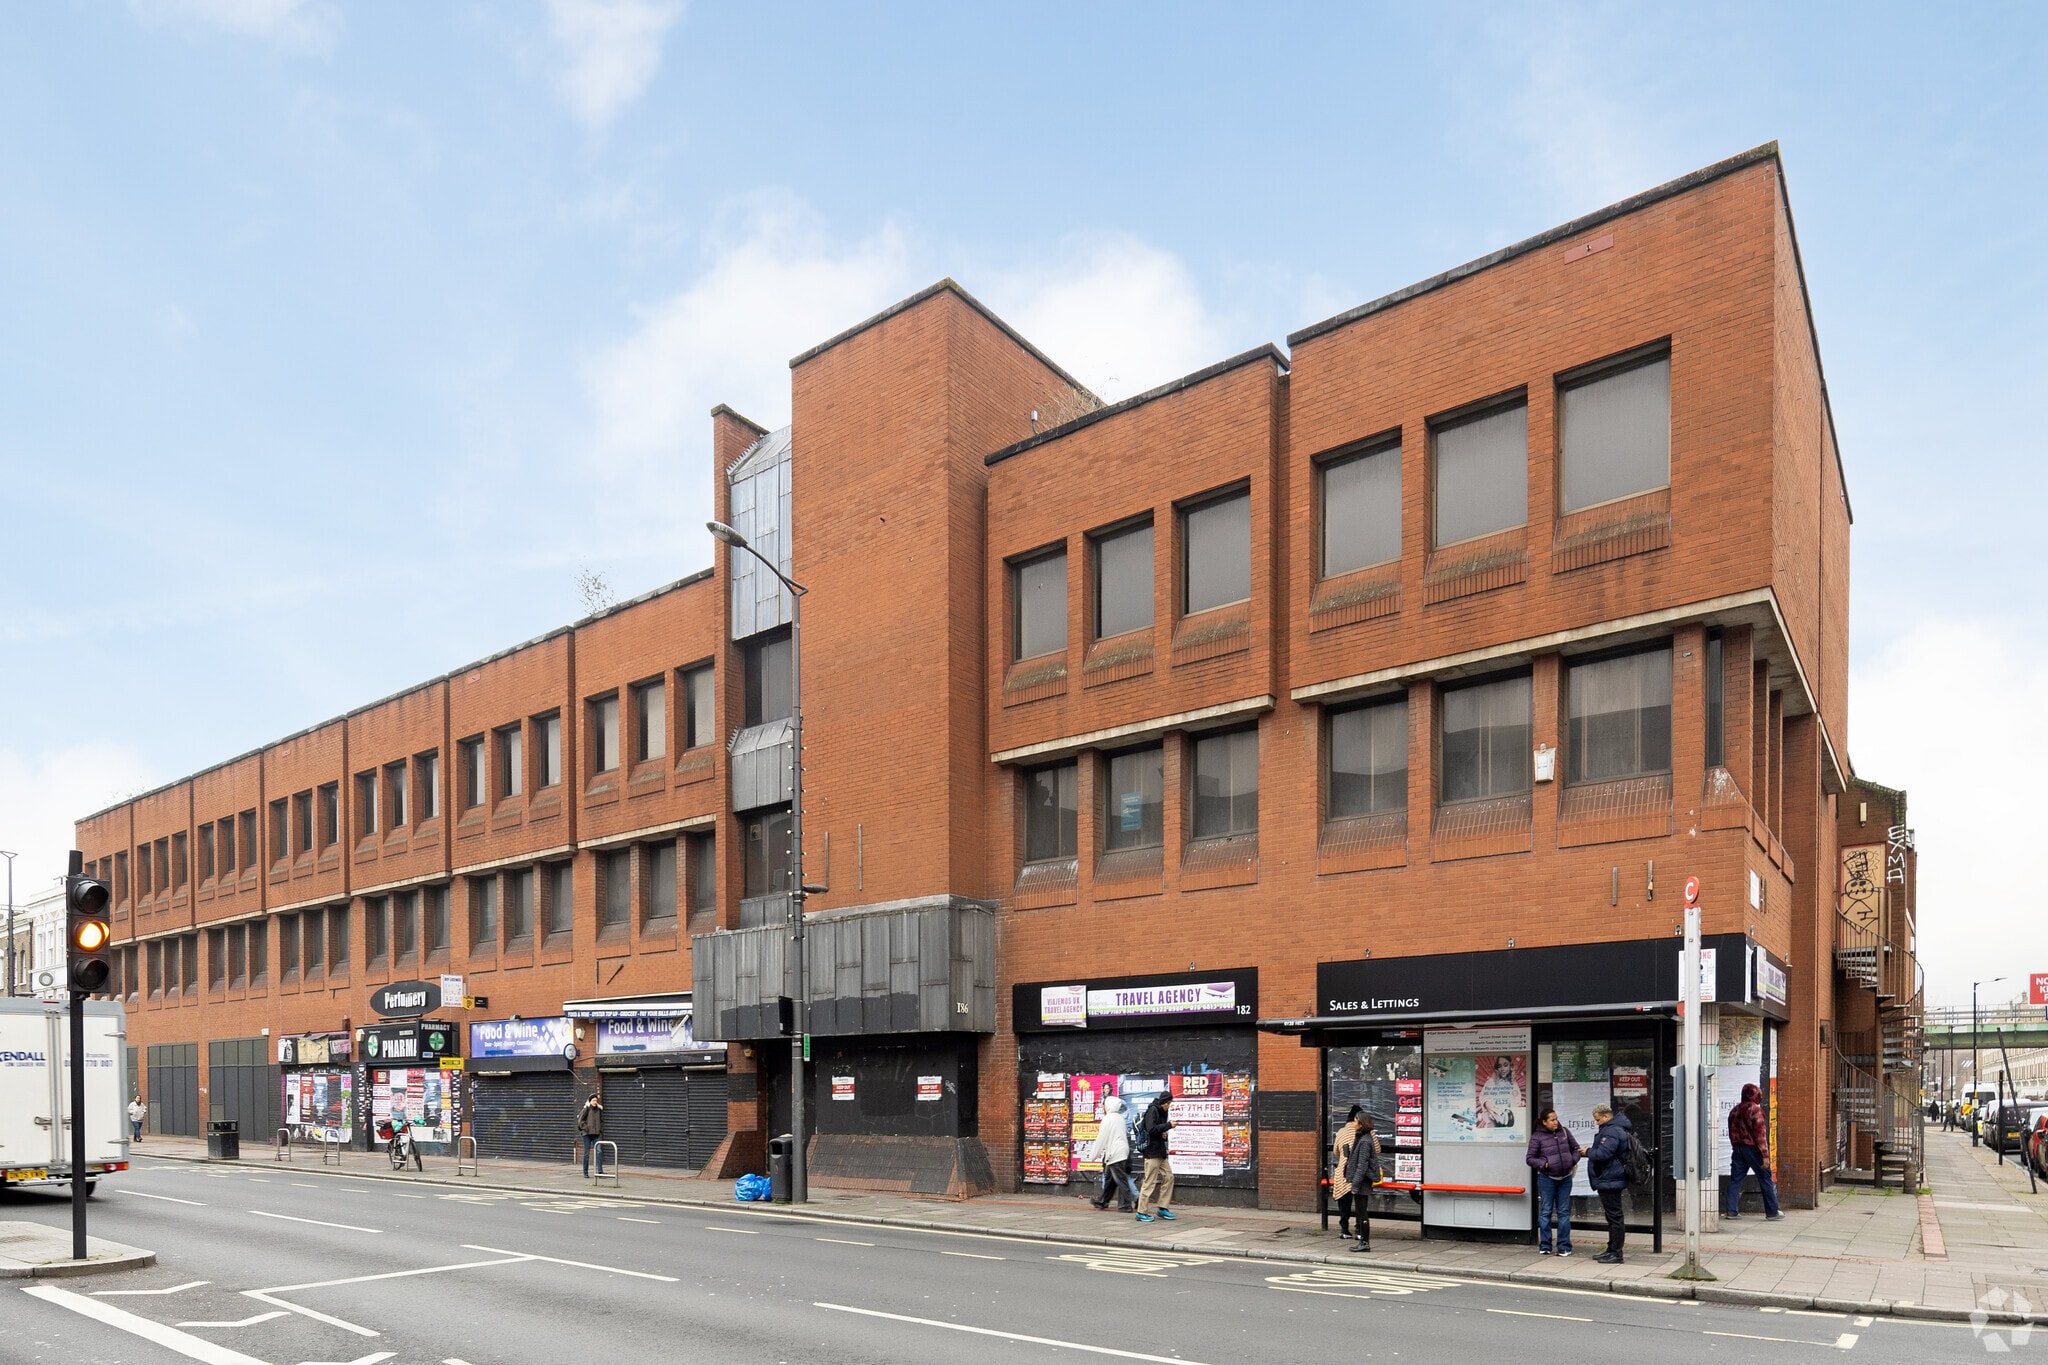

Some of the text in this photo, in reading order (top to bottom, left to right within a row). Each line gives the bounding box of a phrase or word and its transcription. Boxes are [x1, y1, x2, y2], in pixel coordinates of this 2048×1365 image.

[1685, 882, 1694, 900] C
[384, 991, 426, 1010] Perfumery
[1116, 991, 1154, 1006] TRAVEL
[1158, 988, 1201, 1004] AGENCY
[956, 1002, 969, 1014] 186
[1045, 1006, 1062, 1014] TRAVEL
[1063, 1004, 1083, 1013] AGENCY
[1236, 1004, 1251, 1015] 182
[1361, 1000, 1368, 1010] &
[421, 1023, 450, 1031] PHARMACY
[480, 1022, 538, 1040] Food & Wine
[608, 1017, 673, 1034] Food & Wine
[1183, 1076, 1209, 1089] RED
[1182, 1088, 1209, 1096] CARPET
[1398, 1096, 1415, 1107] Get
[1169, 1103, 1221, 1112] SAT 7TH FEB
[1568, 1119, 1596, 1130] trying
